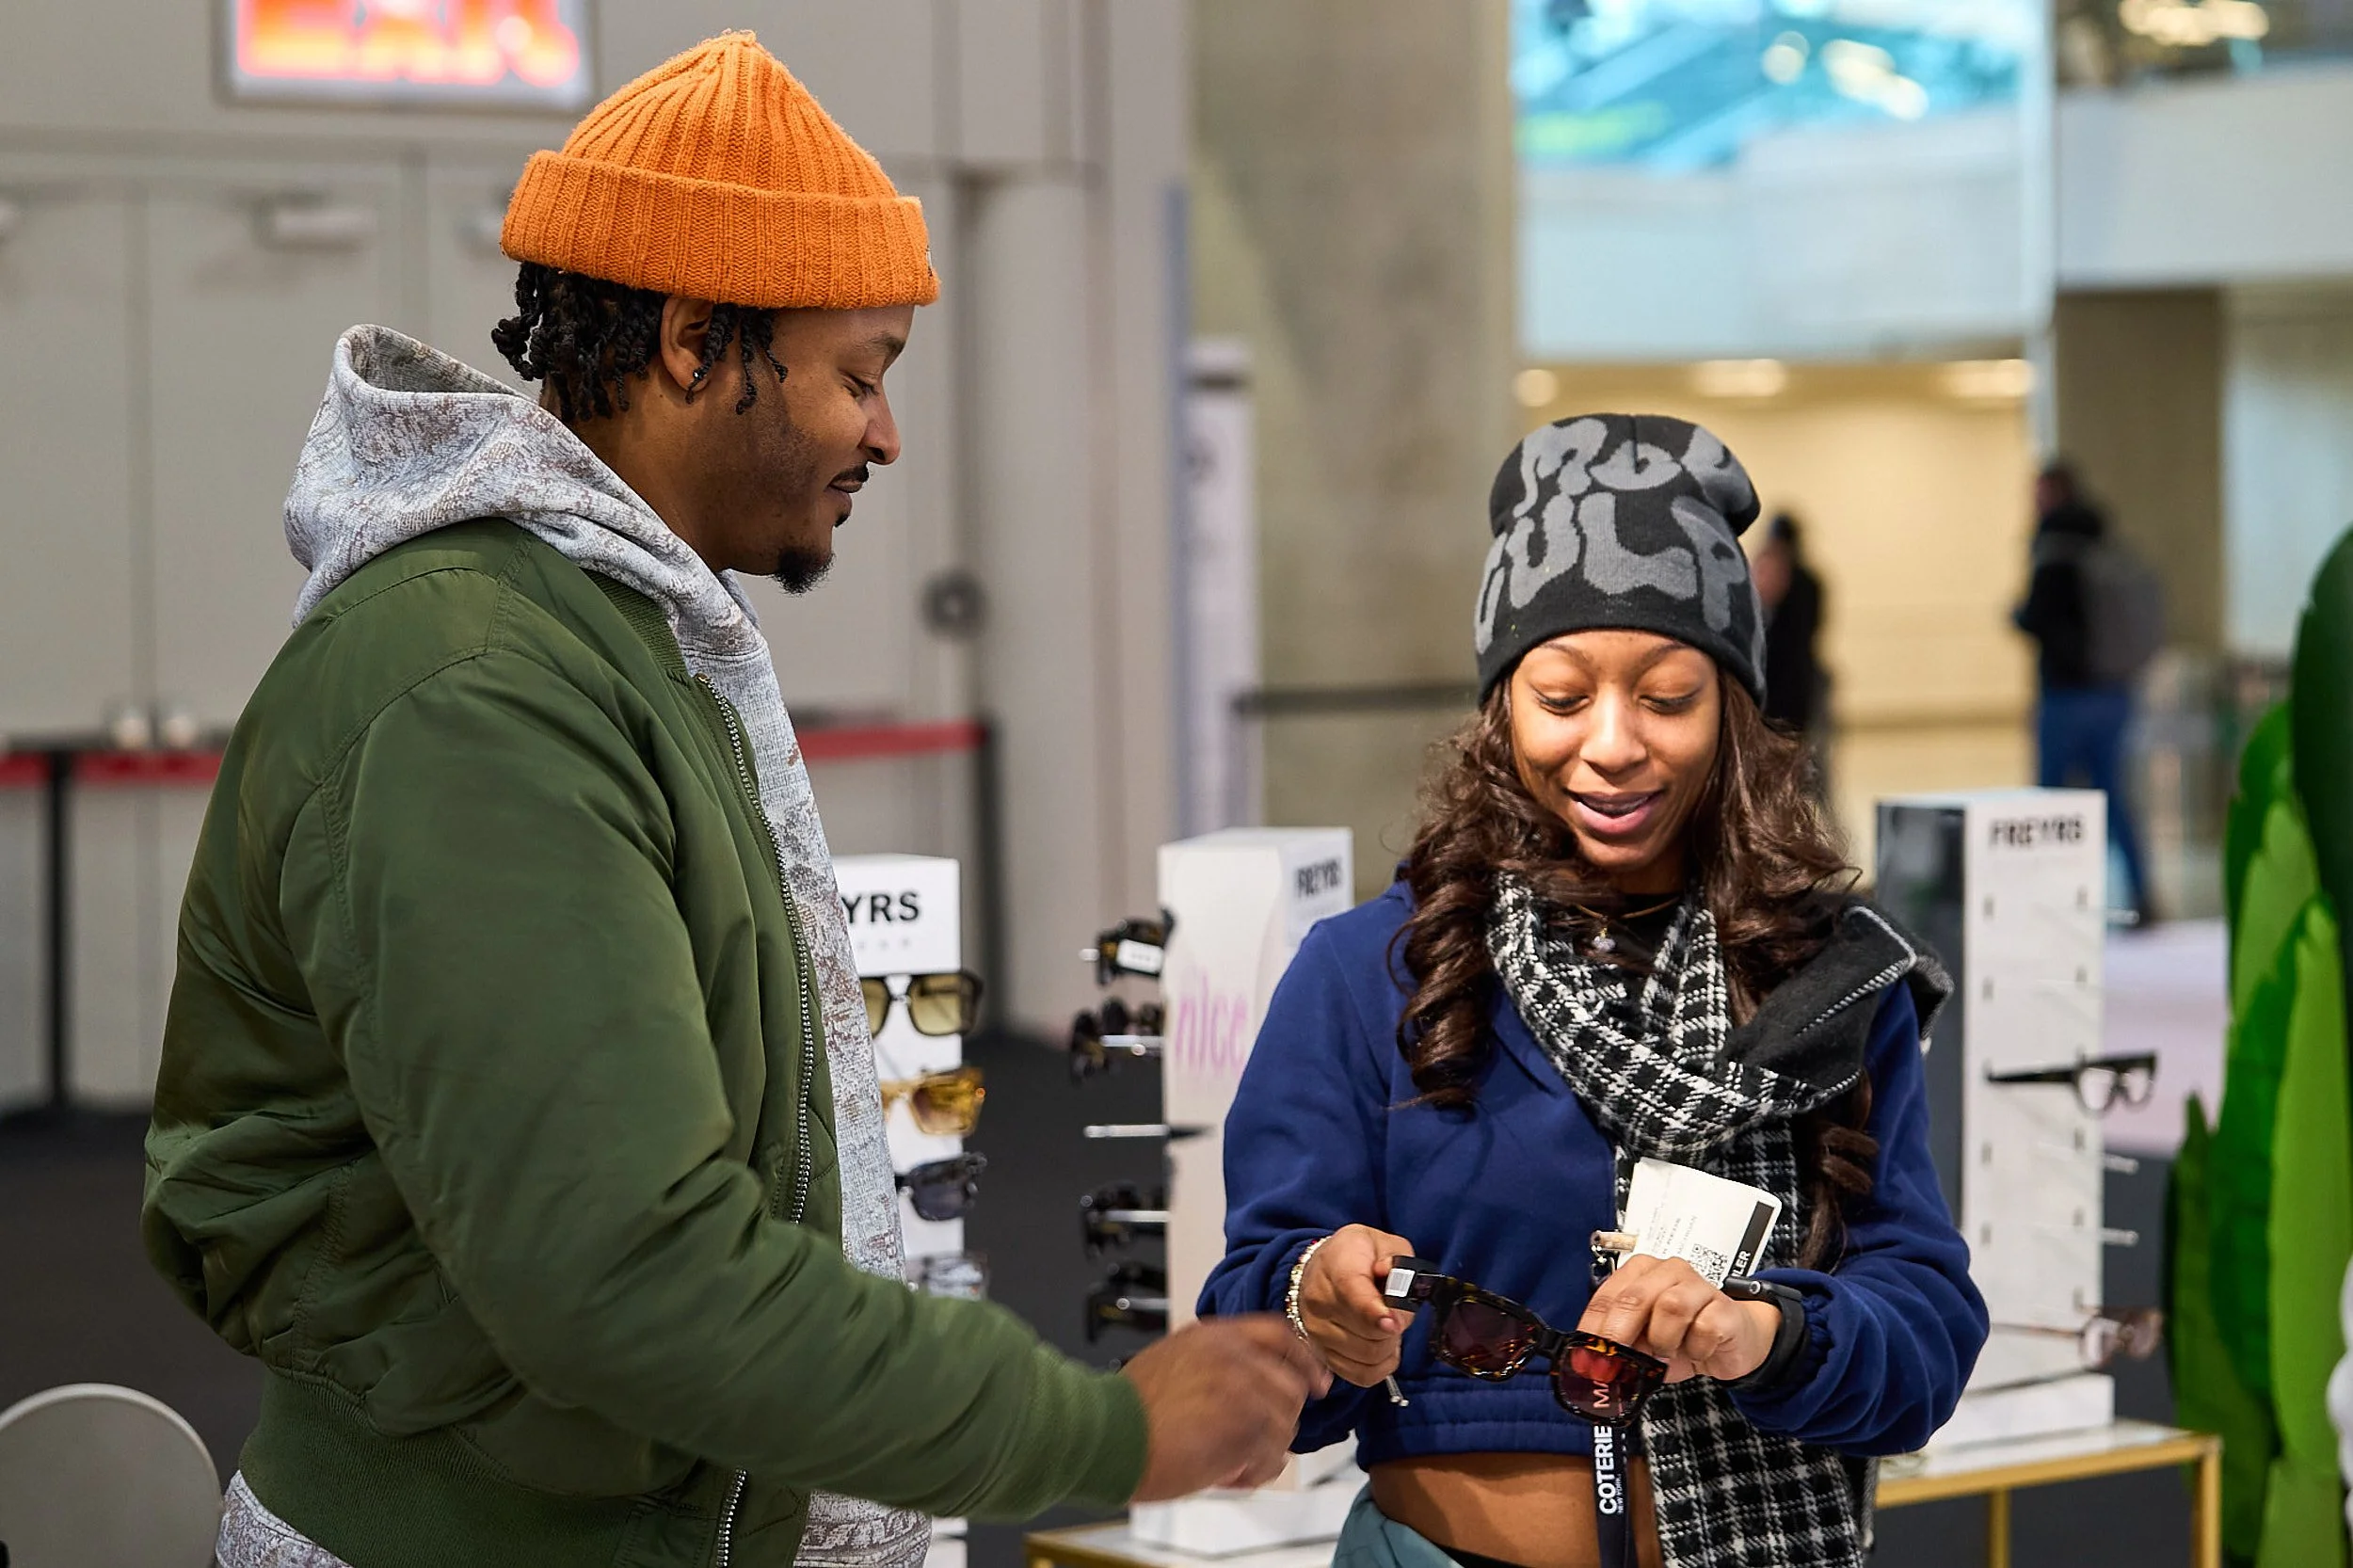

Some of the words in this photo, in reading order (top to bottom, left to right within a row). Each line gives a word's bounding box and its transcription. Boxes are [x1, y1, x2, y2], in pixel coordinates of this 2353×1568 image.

[1989, 814, 2084, 849] FREYRS
[840, 891, 920, 924] YRS
[1593, 1425, 1618, 1515] COTERIE
